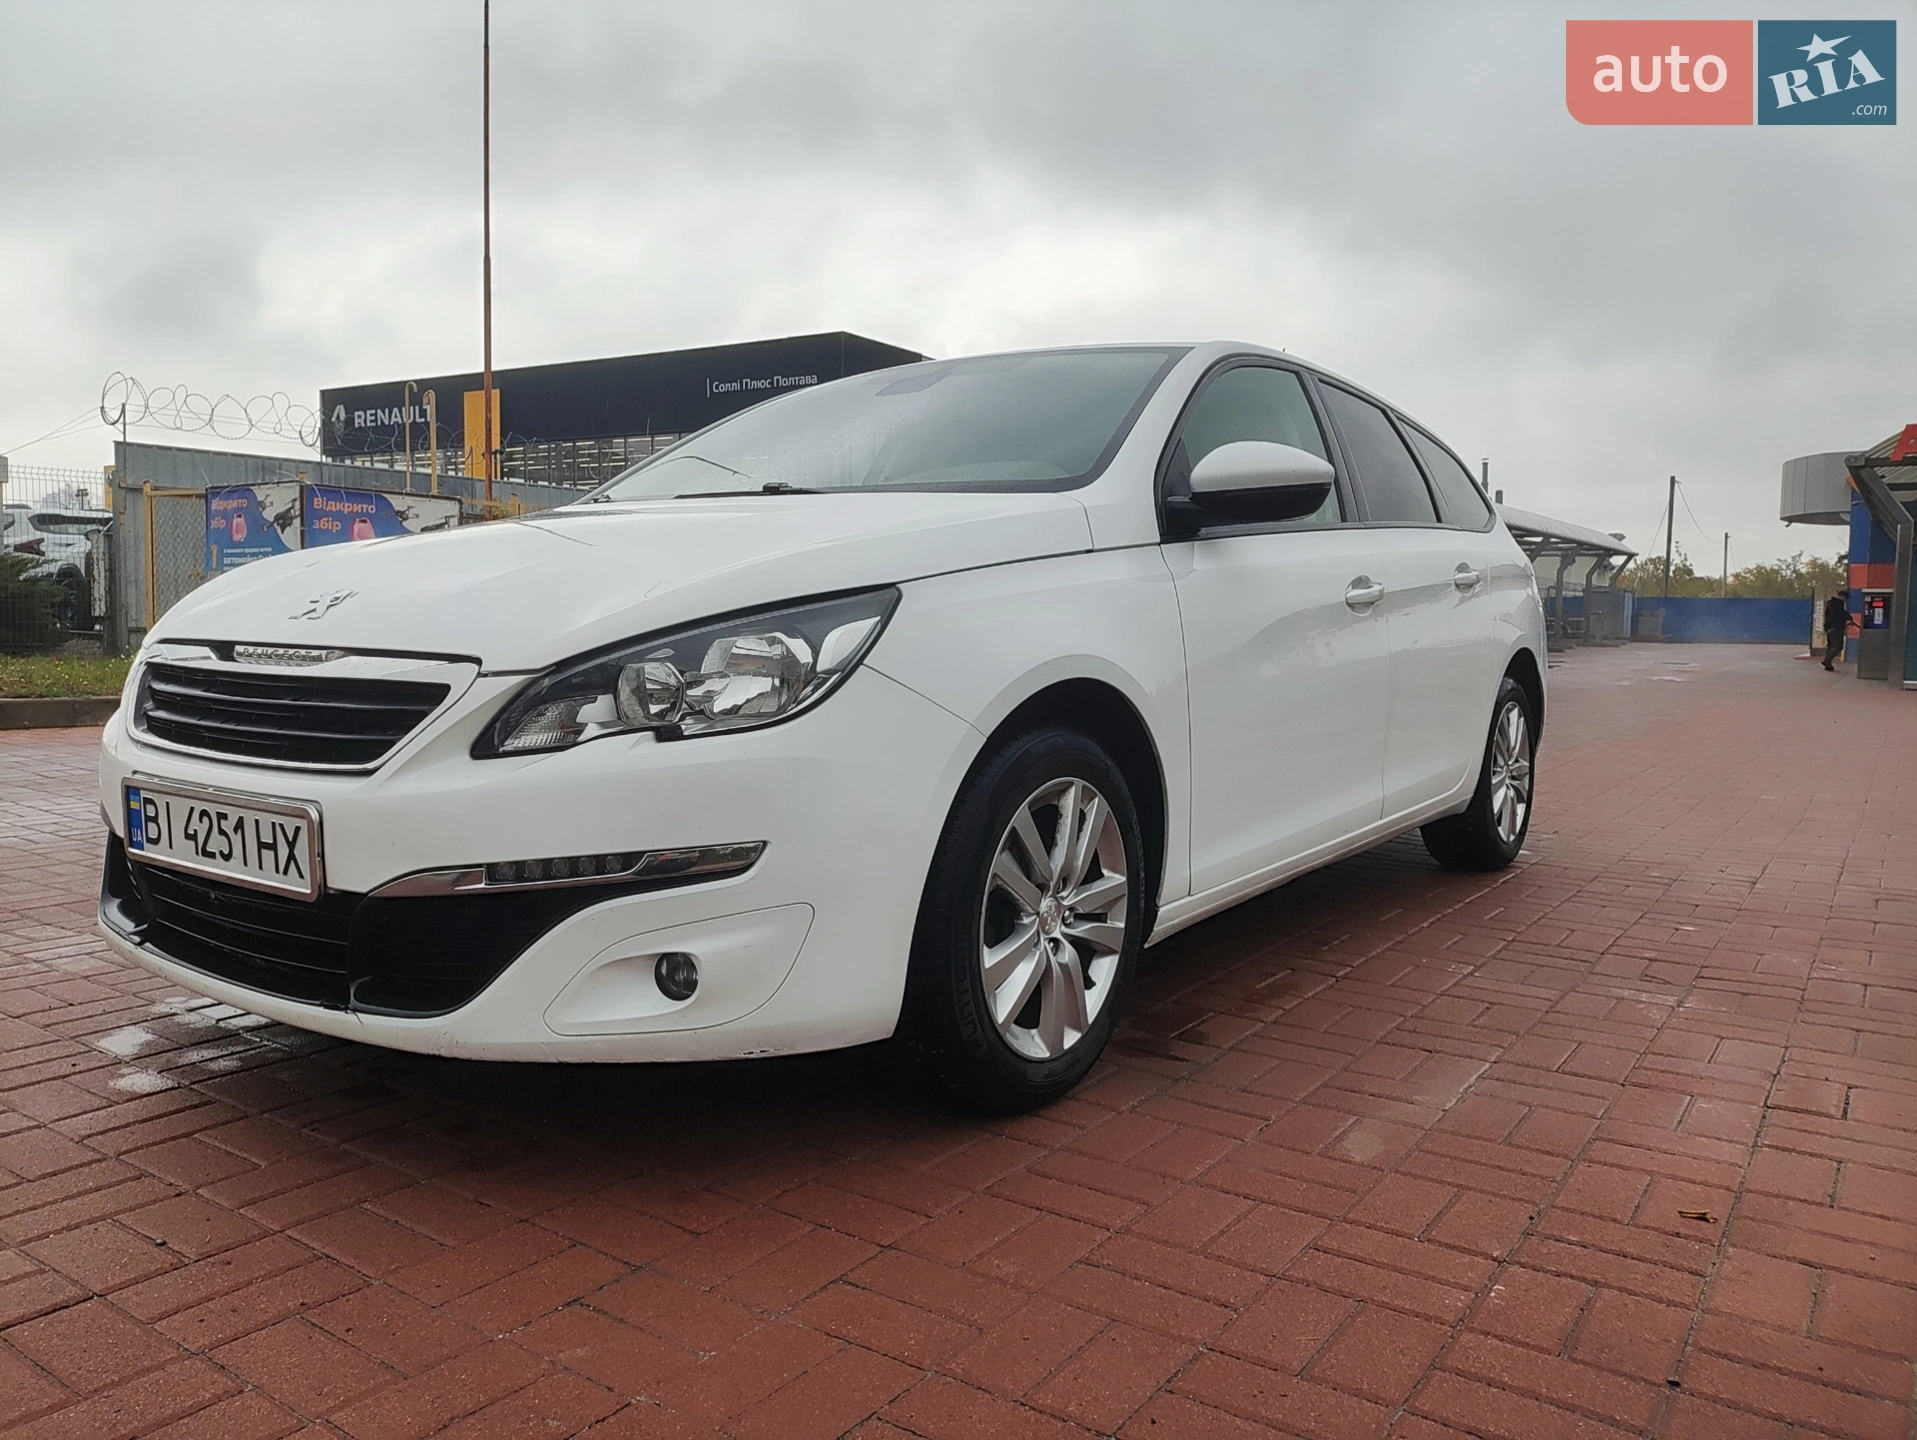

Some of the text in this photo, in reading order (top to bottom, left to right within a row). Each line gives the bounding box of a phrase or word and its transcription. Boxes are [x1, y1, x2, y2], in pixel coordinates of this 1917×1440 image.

[712, 374, 818, 393] Соллі Плюс Полтава
[211, 499, 248, 511] Відкрито
[313, 497, 376, 515] Відкрито
[210, 516, 226, 530] збір
[312, 517, 342, 533] збір
[242, 647, 313, 661] PEUGEOT
[131, 827, 143, 844] UA
[183, 805, 248, 868] 4251
